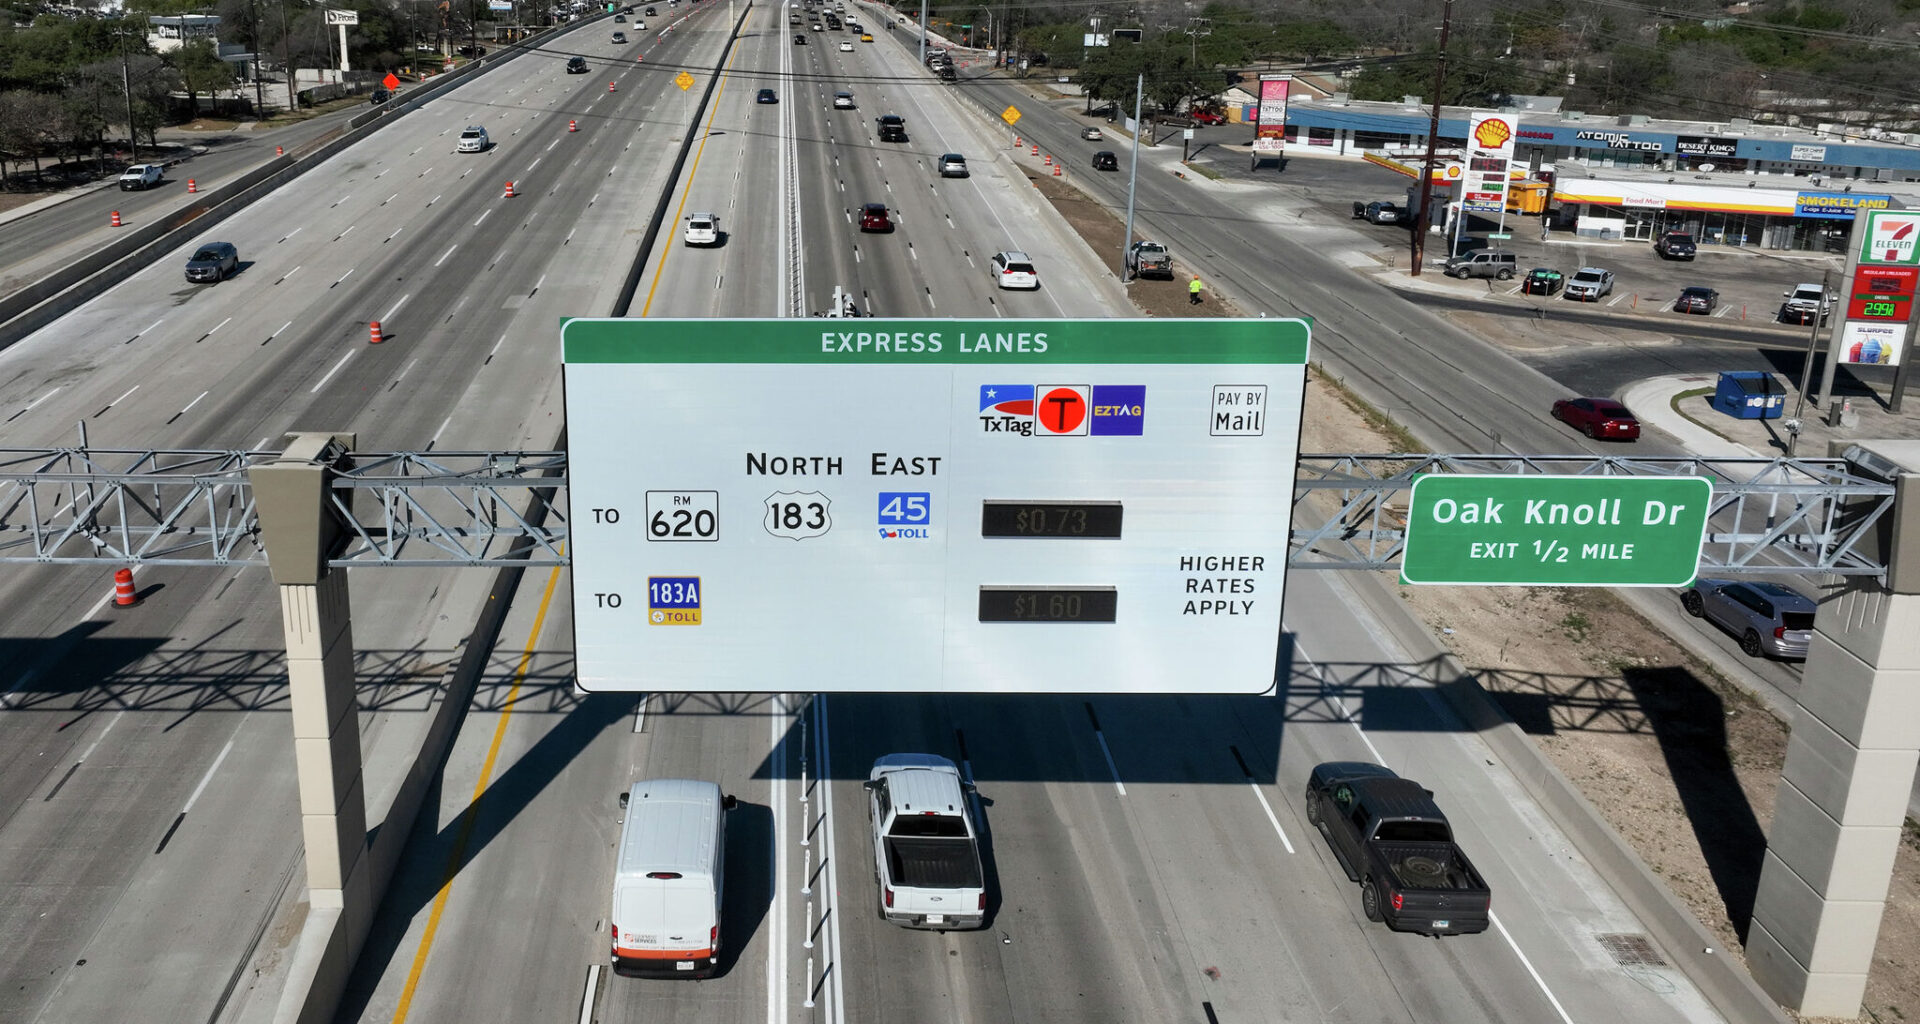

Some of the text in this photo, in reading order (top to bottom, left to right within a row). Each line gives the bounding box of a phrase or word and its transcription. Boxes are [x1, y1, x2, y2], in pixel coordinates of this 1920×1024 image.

[1576, 131, 1629, 142] ATOMIC
[1608, 140, 1662, 151] TATTOO
[1678, 142, 1736, 153] DESERT KINGS
[1796, 195, 1889, 209] SMOKELAND
[1880, 221, 1914, 261] 7
[821, 332, 1048, 353] EXPRESS LANES
[1218, 392, 1262, 406] PAY BY
[1048, 397, 1078, 431] T
[1215, 410, 1260, 430] Mail
[979, 416, 1033, 437] TxTag
[746, 452, 843, 476] NORTH
[871, 452, 942, 476] EAST
[673, 496, 691, 506] RM
[880, 496, 927, 521] 45
[592, 508, 620, 524] TO
[771, 502, 826, 530] 183
[1015, 508, 1087, 534] $0.73
[1432, 498, 1685, 526] Oak Knoll Dr
[651, 509, 716, 537] 620
[897, 528, 929, 538] TOLL
[1470, 542, 1519, 559] EXIT
[1581, 543, 1634, 560] MILE
[1179, 556, 1265, 572] HIGHER
[650, 582, 698, 604] 183A
[1185, 578, 1255, 594] RATES
[594, 593, 622, 608] TO
[1014, 594, 1082, 618] $1.60
[1182, 600, 1254, 615] APPLY
[666, 612, 699, 622] TOLL
